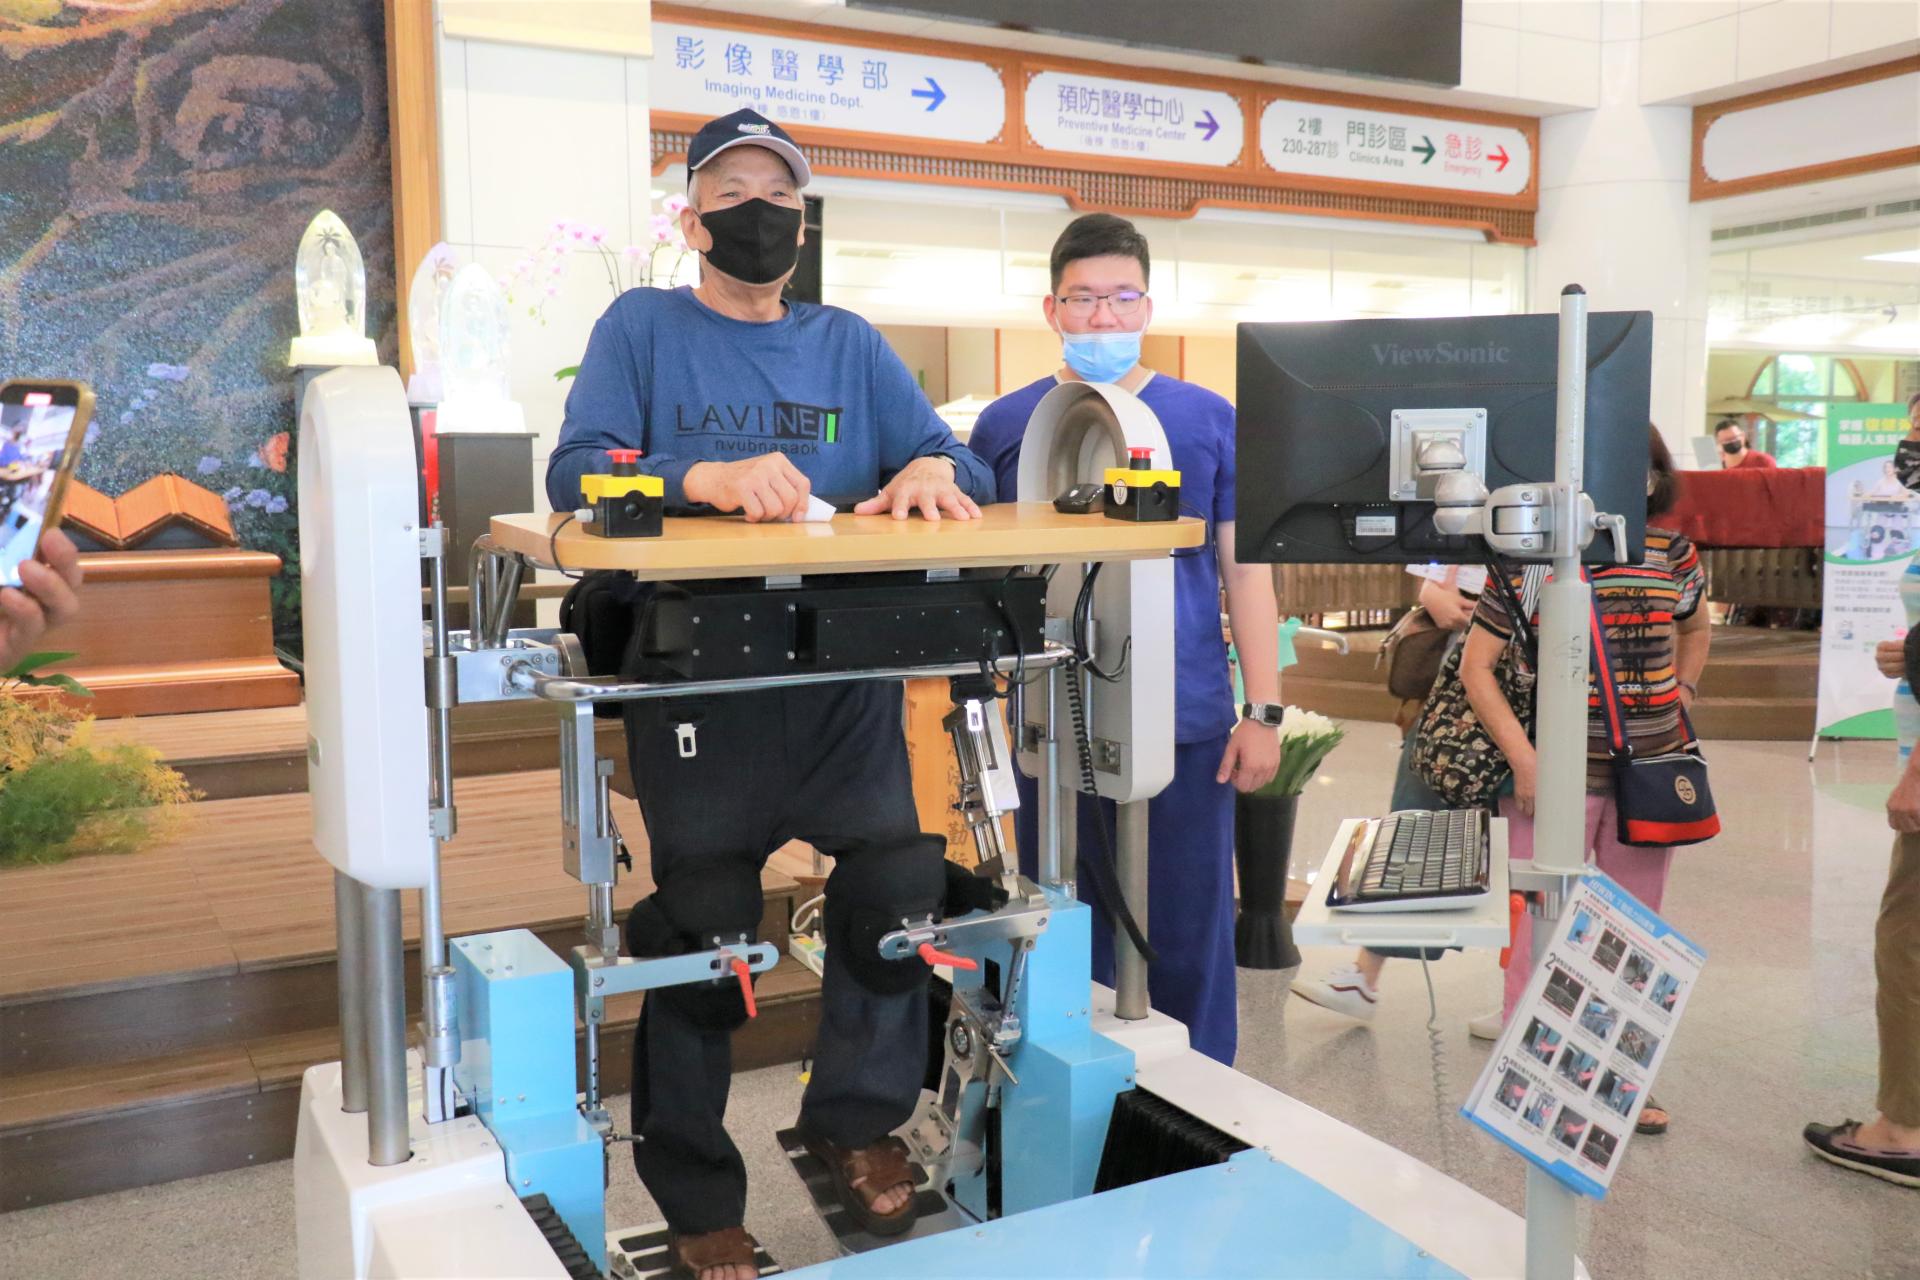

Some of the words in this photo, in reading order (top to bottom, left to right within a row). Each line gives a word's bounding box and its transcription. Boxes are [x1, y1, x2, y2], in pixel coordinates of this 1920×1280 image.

[675, 36, 889, 92] 影像醫學部
[704, 78, 761, 99] Imaging
[765, 86, 826, 104] Medicine
[830, 92, 863, 110] Dept.
[1058, 84, 1184, 125] 預防醫學中心
[1057, 116, 1109, 132] Preventive
[1112, 122, 1153, 137] Medicine
[1156, 127, 1186, 140] Center
[1347, 120, 1407, 151] 門診區
[1349, 151, 1381, 165] Clinics
[1383, 155, 1404, 167] Area
[1445, 133, 1482, 160] 急診
[1370, 341, 1511, 366] ViewSonic
